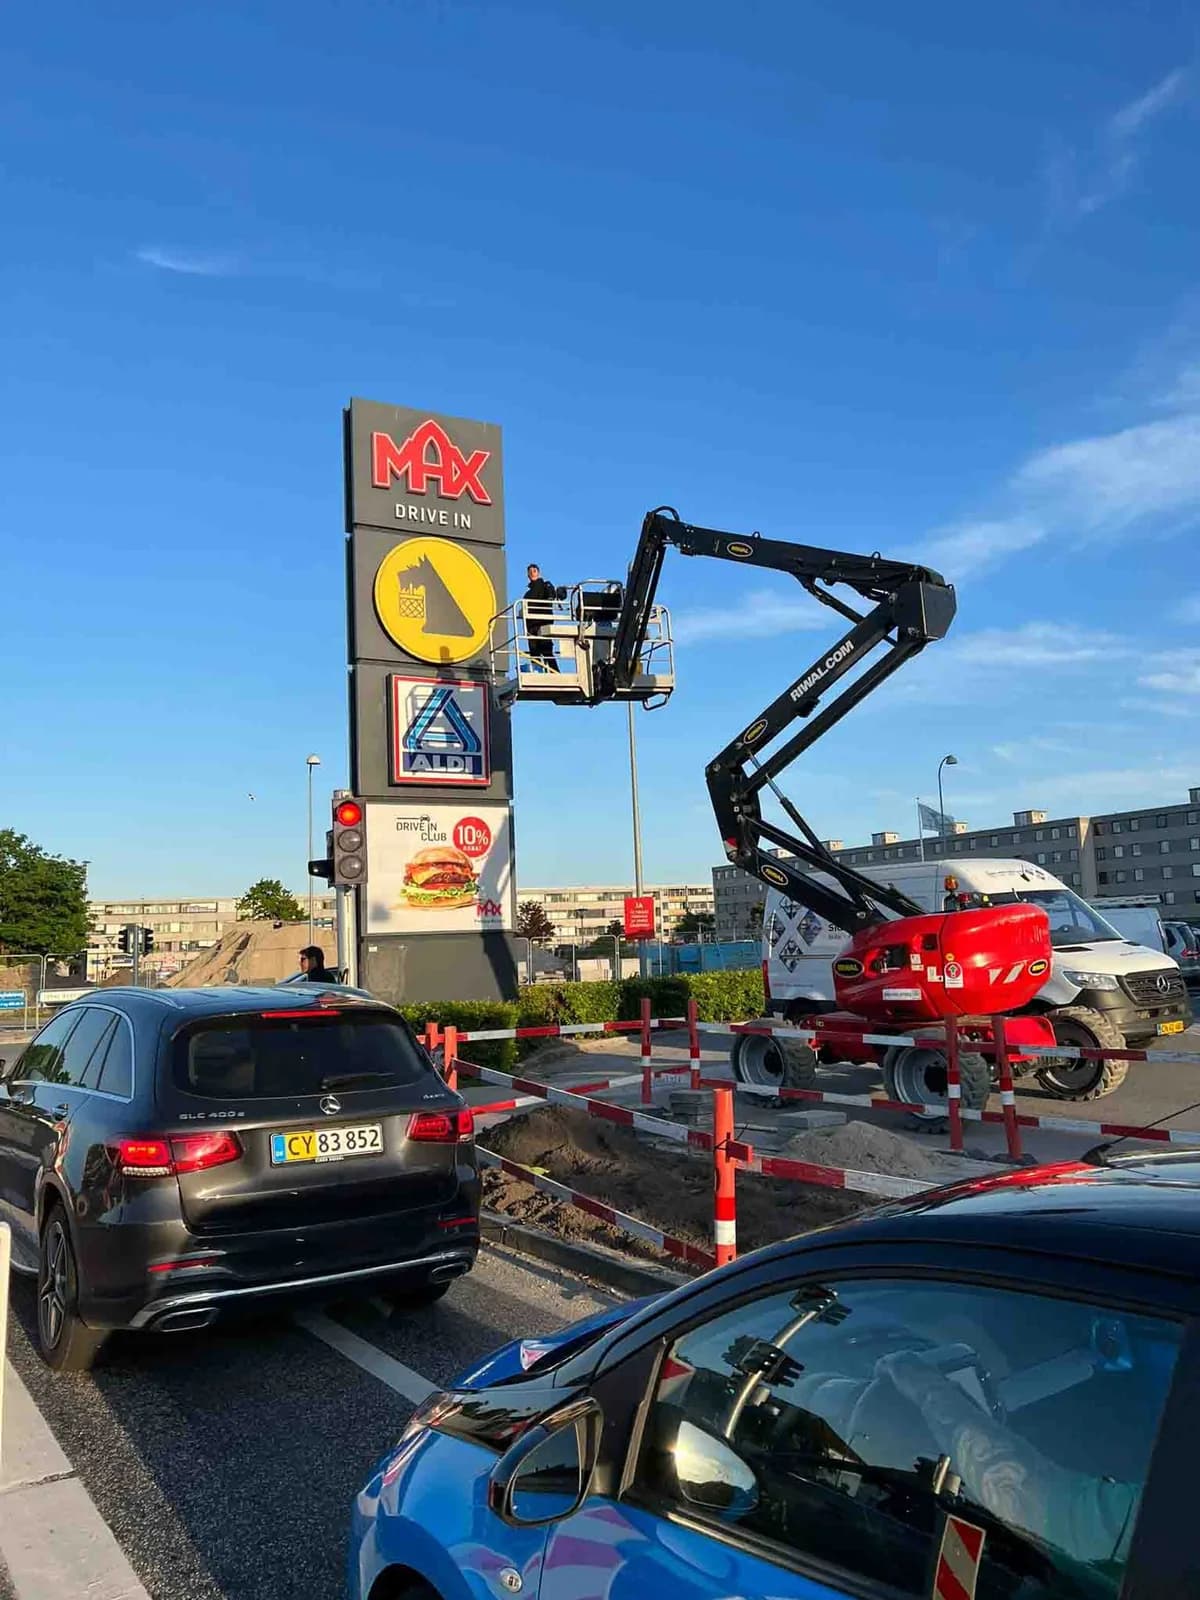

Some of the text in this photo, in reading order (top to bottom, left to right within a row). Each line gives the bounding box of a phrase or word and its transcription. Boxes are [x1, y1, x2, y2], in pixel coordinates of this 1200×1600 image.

[372, 419, 492, 505] MAX
[395, 503, 471, 528] DRIVE IN
[790, 640, 855, 701] RIWAL.COM
[410, 754, 473, 773] ALDI
[396, 821, 437, 832] DRIVE IN
[457, 825, 489, 845] 10%
[421, 832, 447, 842] CLUB
[476, 898, 502, 917] MAX
[179, 1112, 206, 1120] GLC
[288, 1129, 379, 1156] CY 83 852
